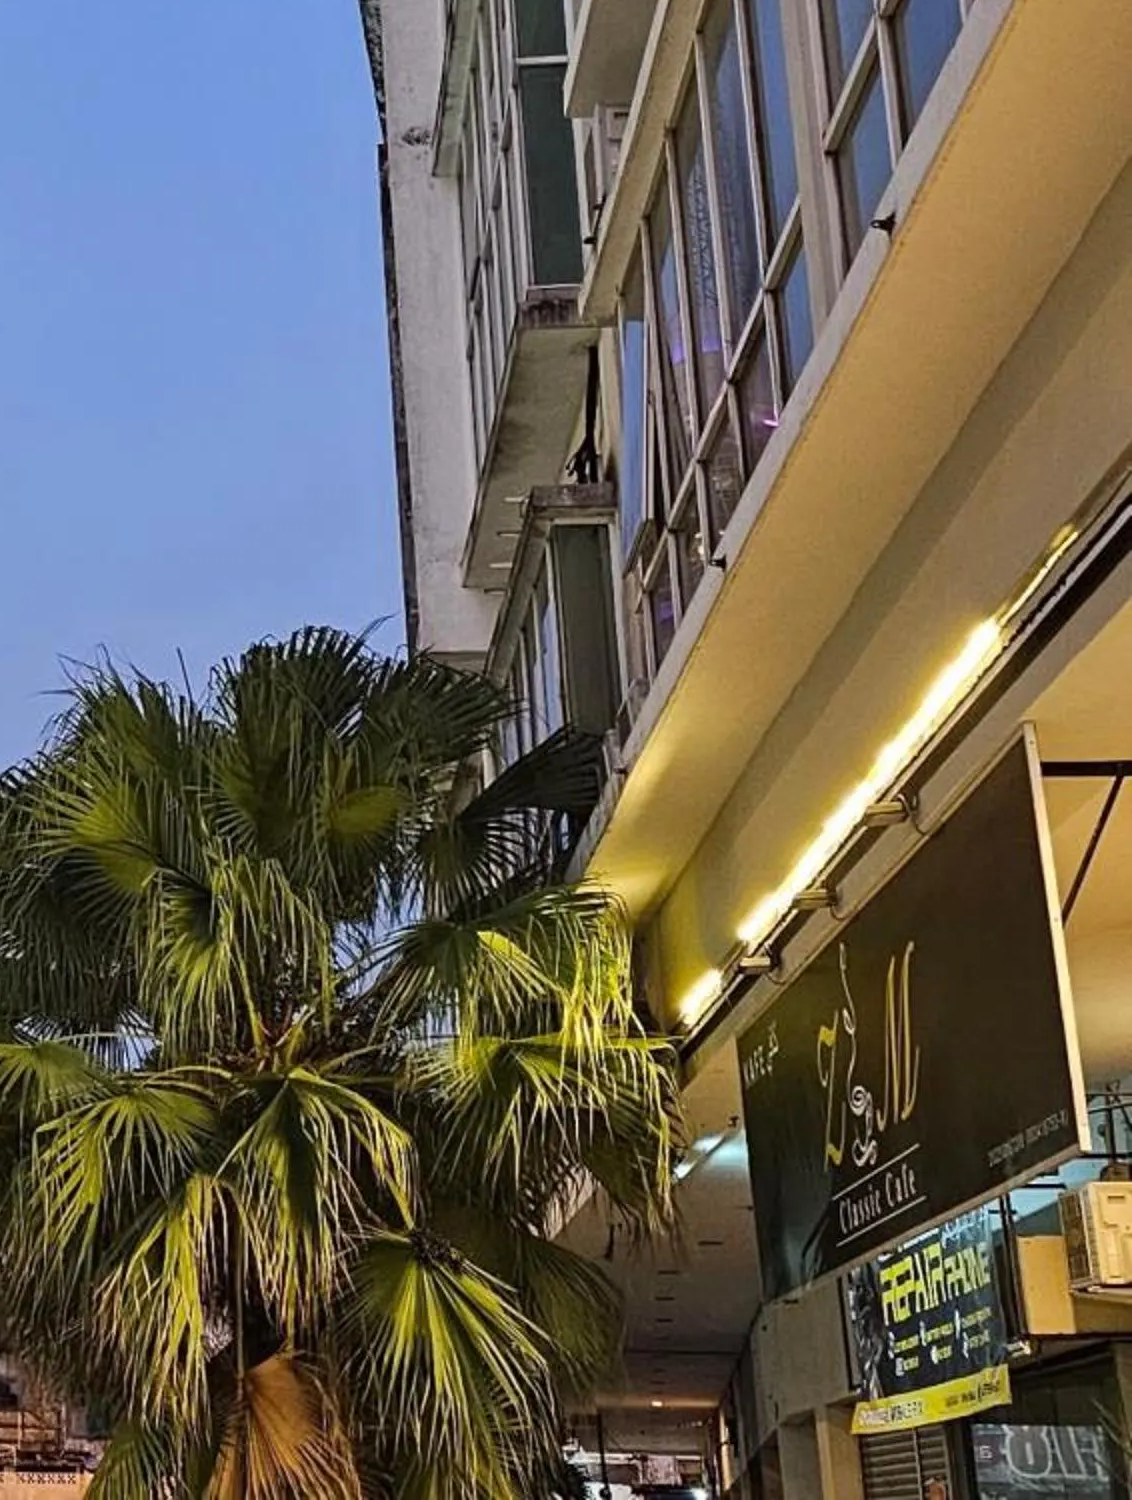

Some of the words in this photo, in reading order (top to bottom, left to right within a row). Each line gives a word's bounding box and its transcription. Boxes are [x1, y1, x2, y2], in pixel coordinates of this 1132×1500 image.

[839, 1184, 882, 1234] Classic
[885, 1163, 916, 1208] Cafe
[879, 1242, 947, 1327] REPAIR
